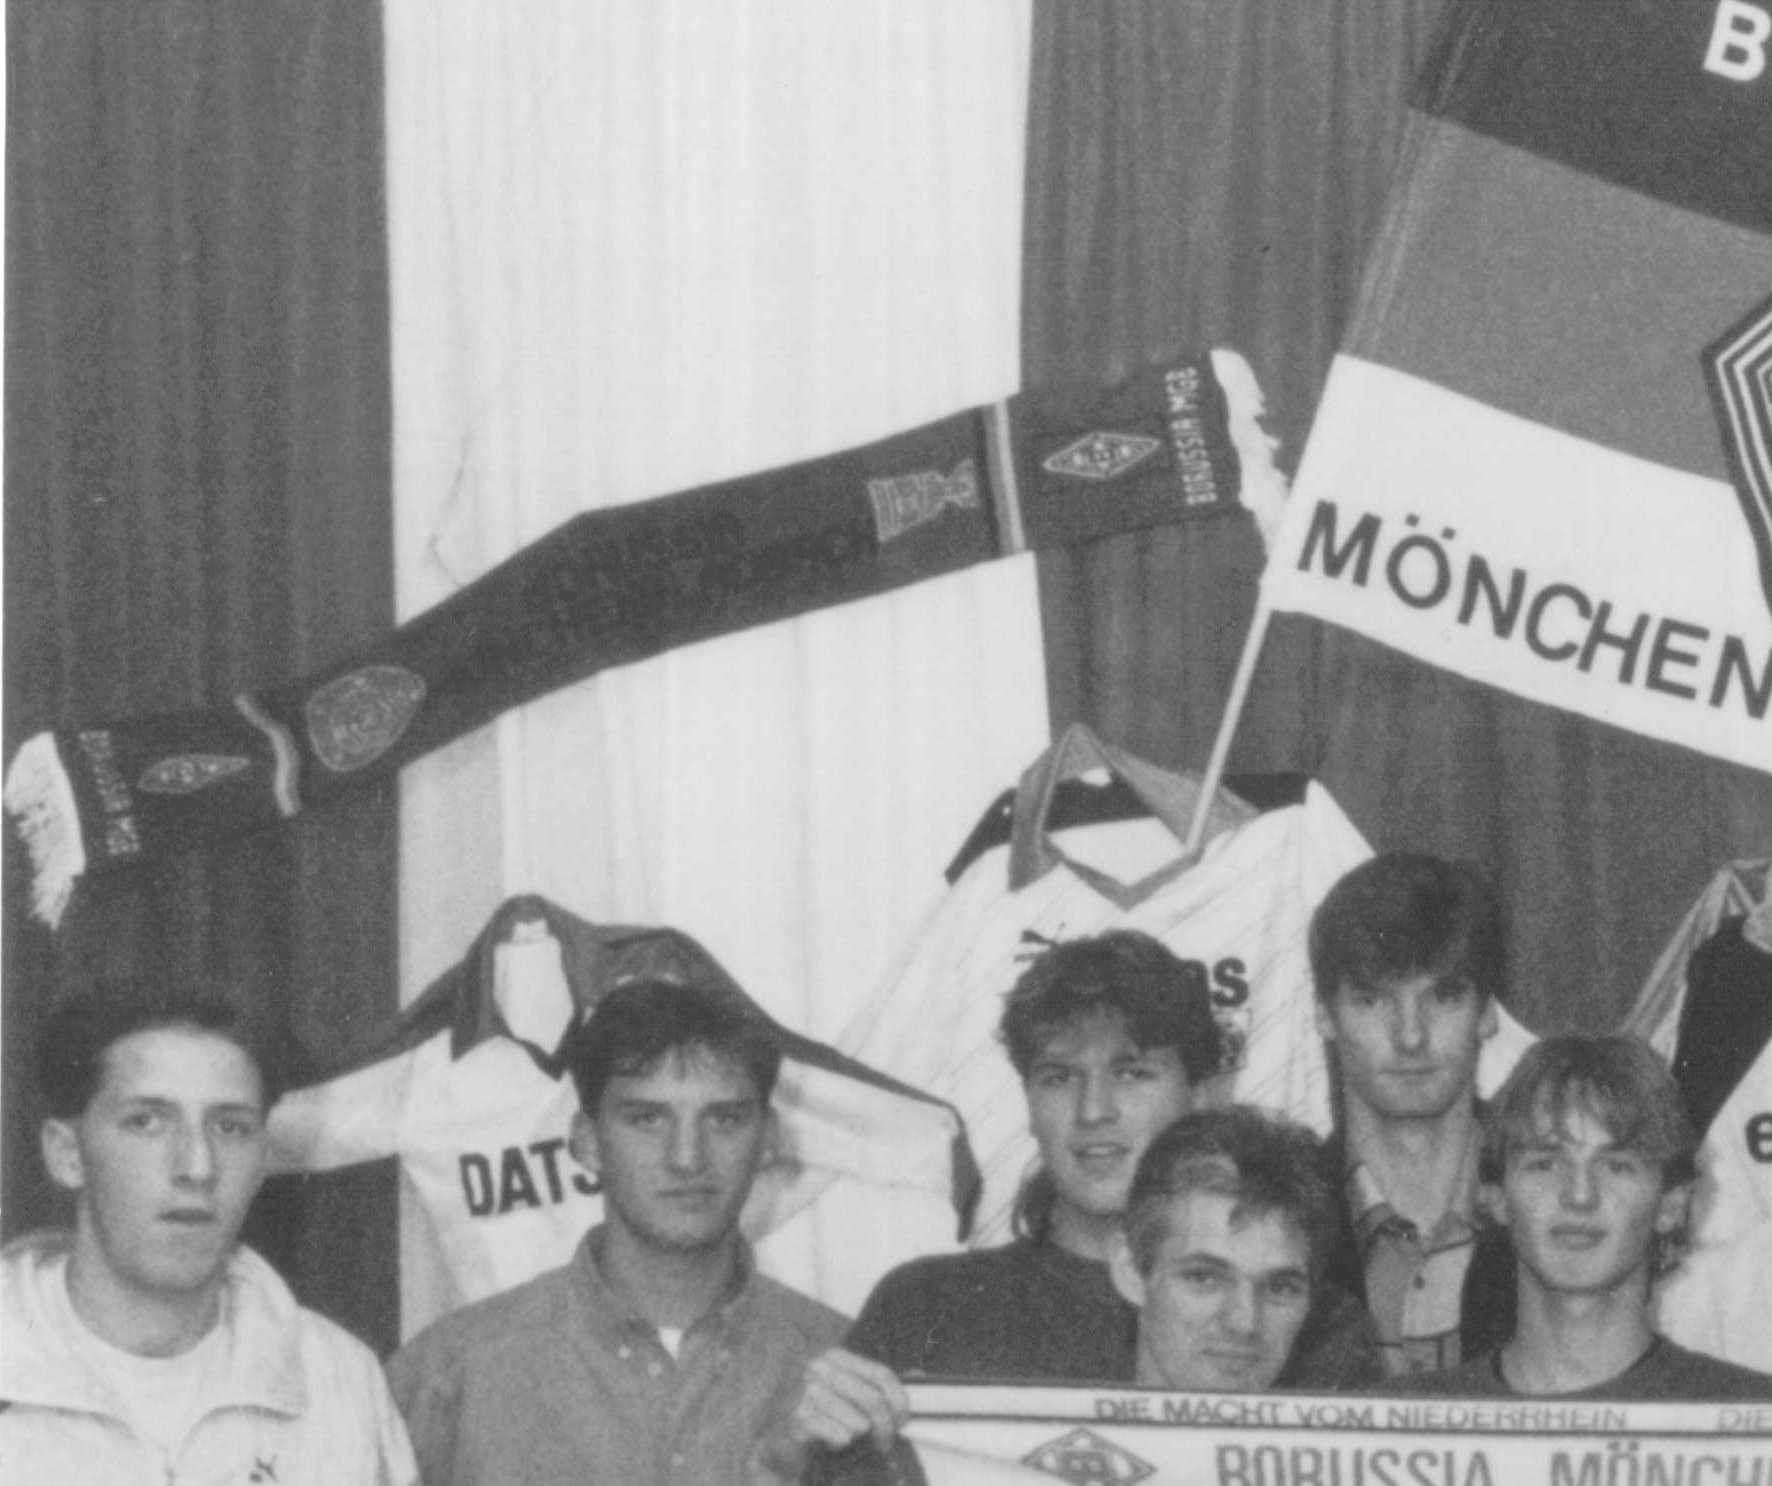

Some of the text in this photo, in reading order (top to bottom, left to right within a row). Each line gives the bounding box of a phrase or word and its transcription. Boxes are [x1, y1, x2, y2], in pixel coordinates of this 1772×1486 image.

[1095, 1398, 1627, 1431] DIE MACHT VOM NIEDERRHEIN
